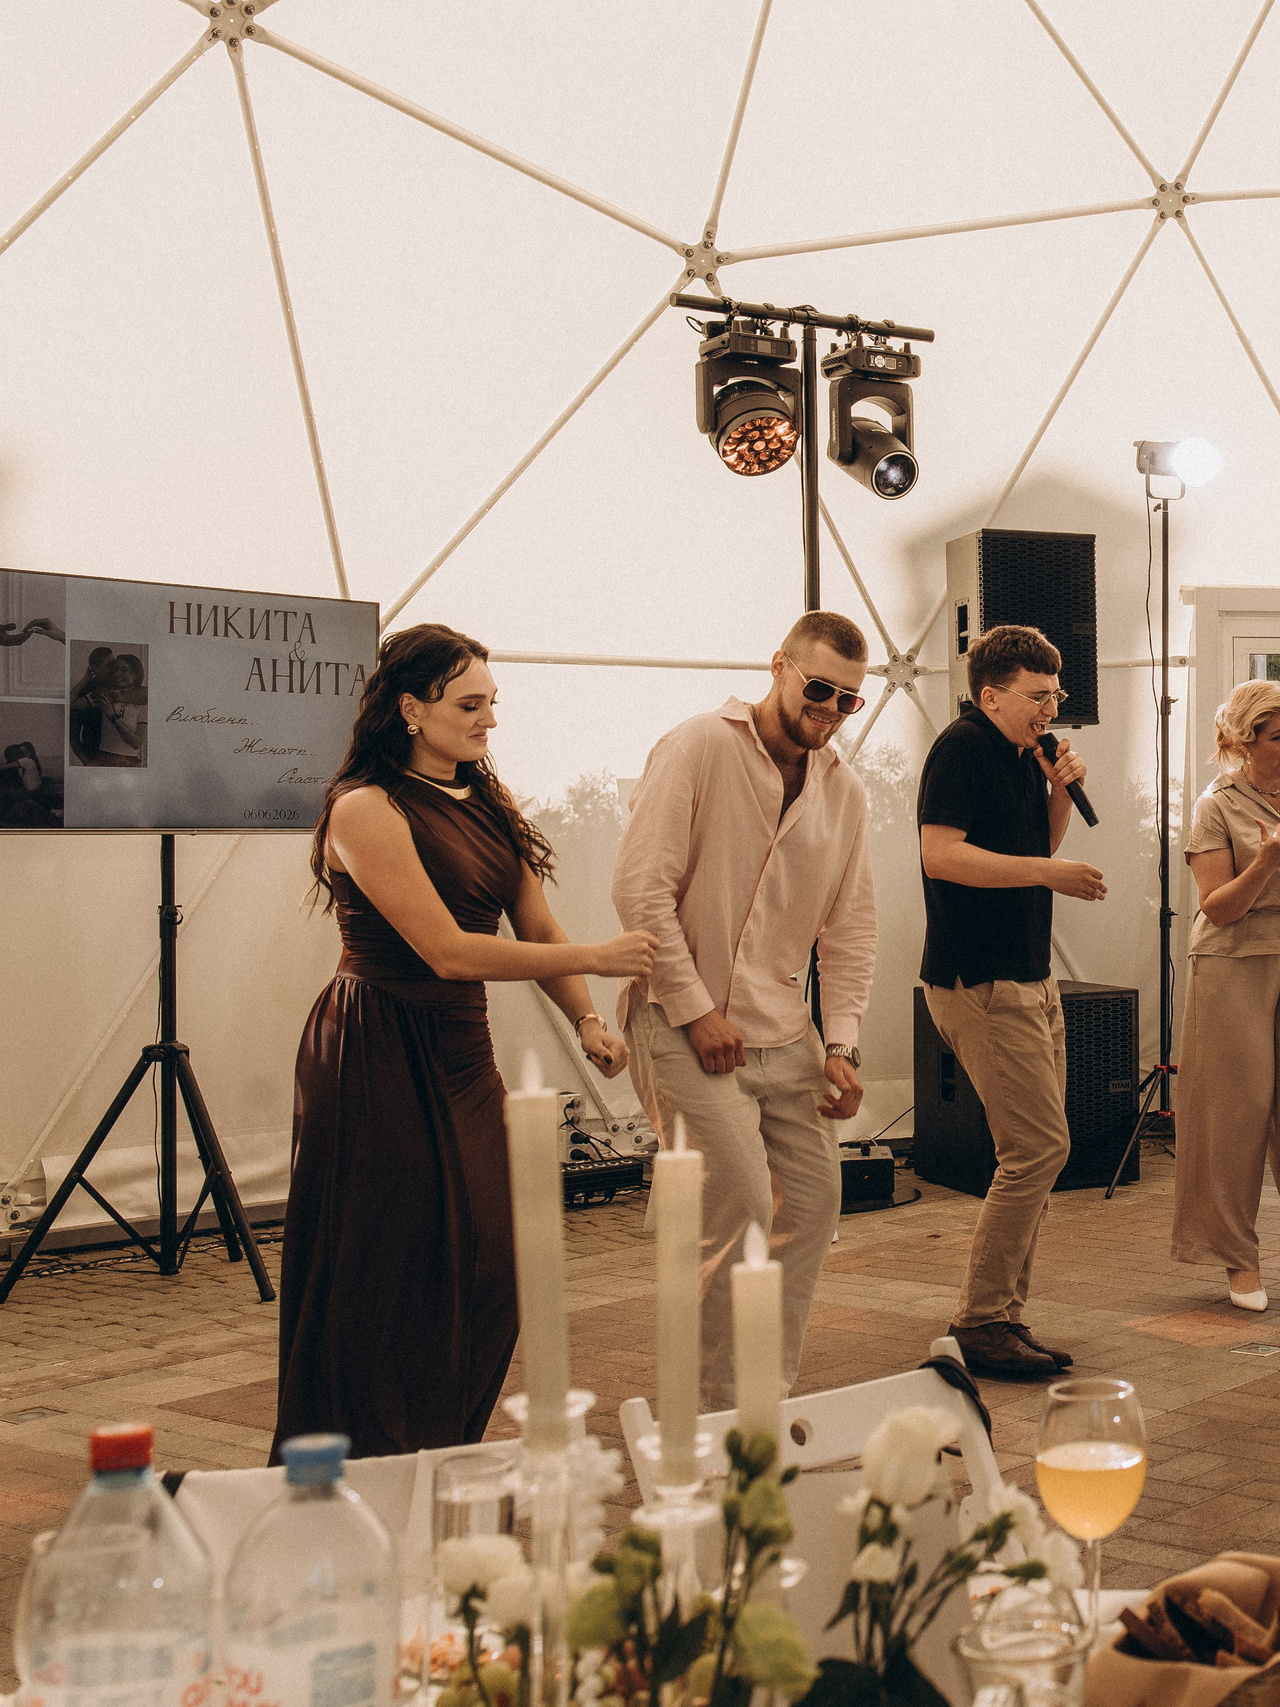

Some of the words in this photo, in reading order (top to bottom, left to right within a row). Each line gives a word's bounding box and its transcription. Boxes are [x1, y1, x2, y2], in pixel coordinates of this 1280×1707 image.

[168, 601, 317, 644] НИКИТА
[288, 640, 309, 662] &
[244, 657, 367, 697] АНИТА
[277, 767, 329, 785] Счаст
